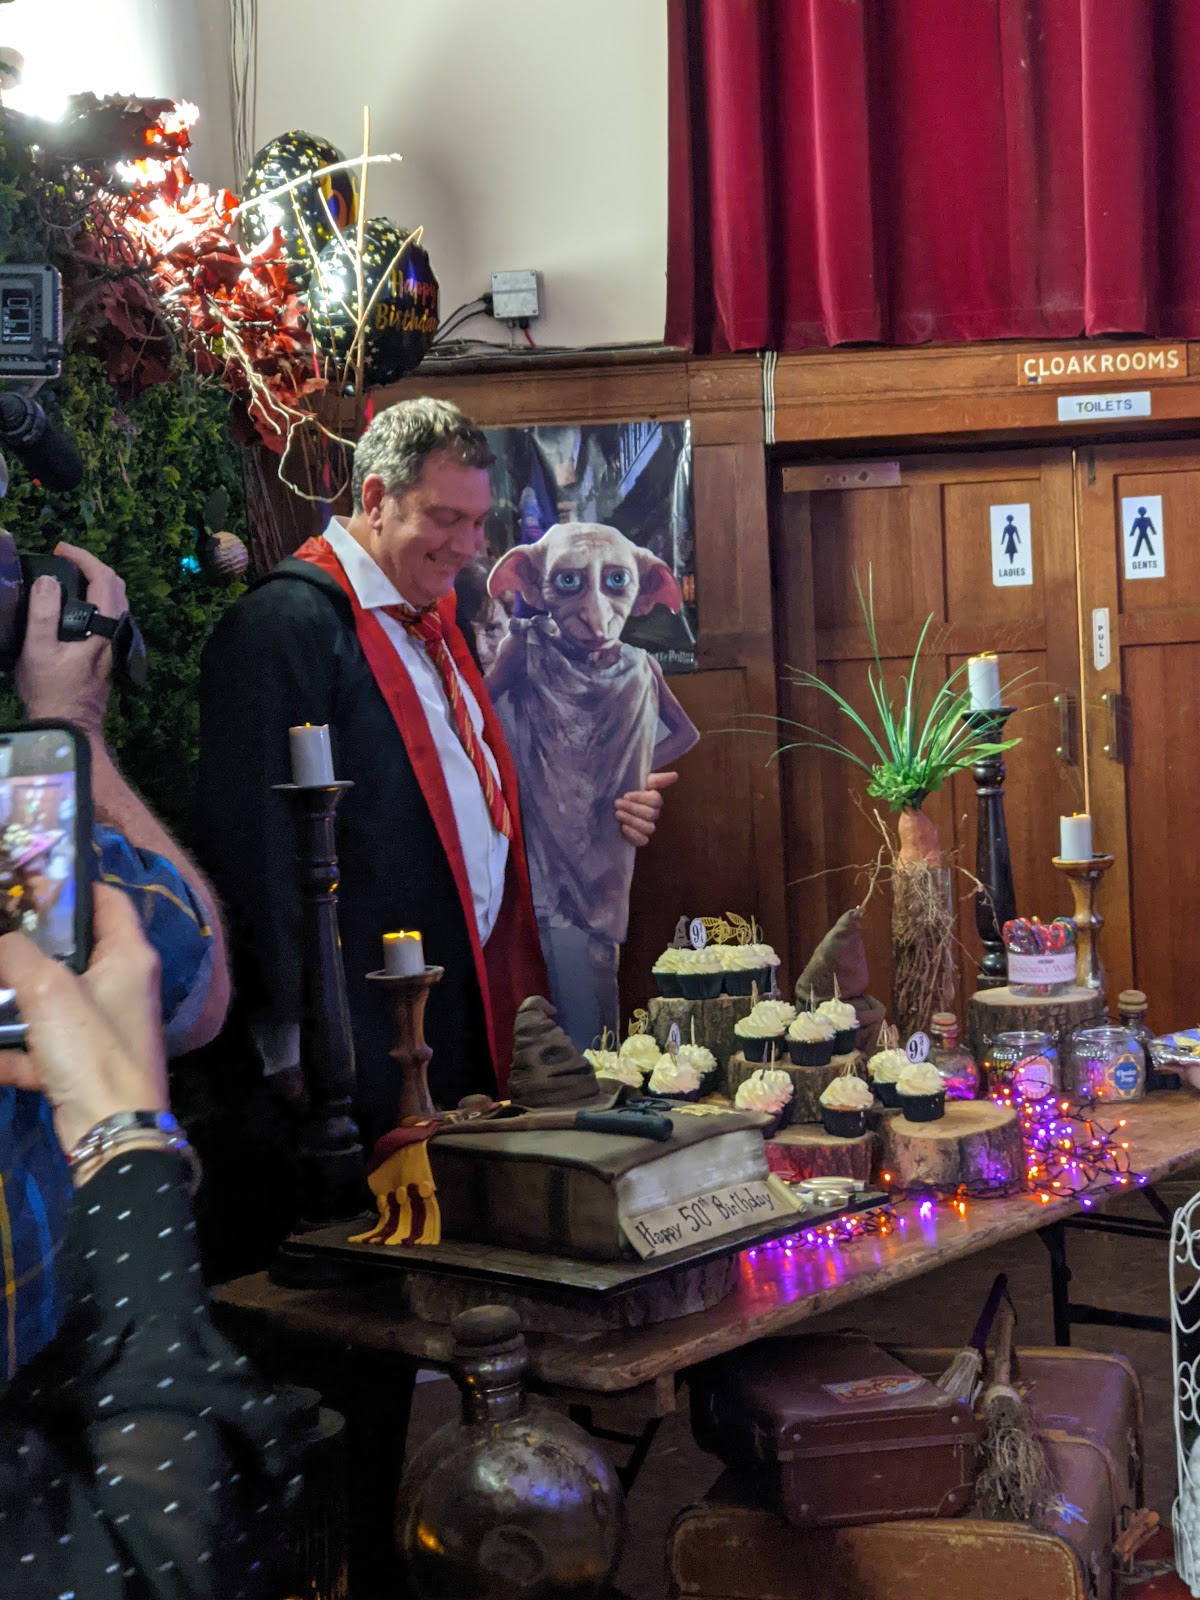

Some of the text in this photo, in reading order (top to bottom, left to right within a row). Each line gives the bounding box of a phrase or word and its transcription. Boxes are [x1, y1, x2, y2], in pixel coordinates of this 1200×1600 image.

[1023, 349, 1180, 377] CLOAKROOMS
[1076, 399, 1133, 413] TOILETS
[998, 567, 1026, 577] LADIES
[1132, 560, 1158, 570] GENTS
[1097, 625, 1105, 657] PULL
[634, 1221, 682, 1249] Happy
[711, 1187, 775, 1220] Birthday
